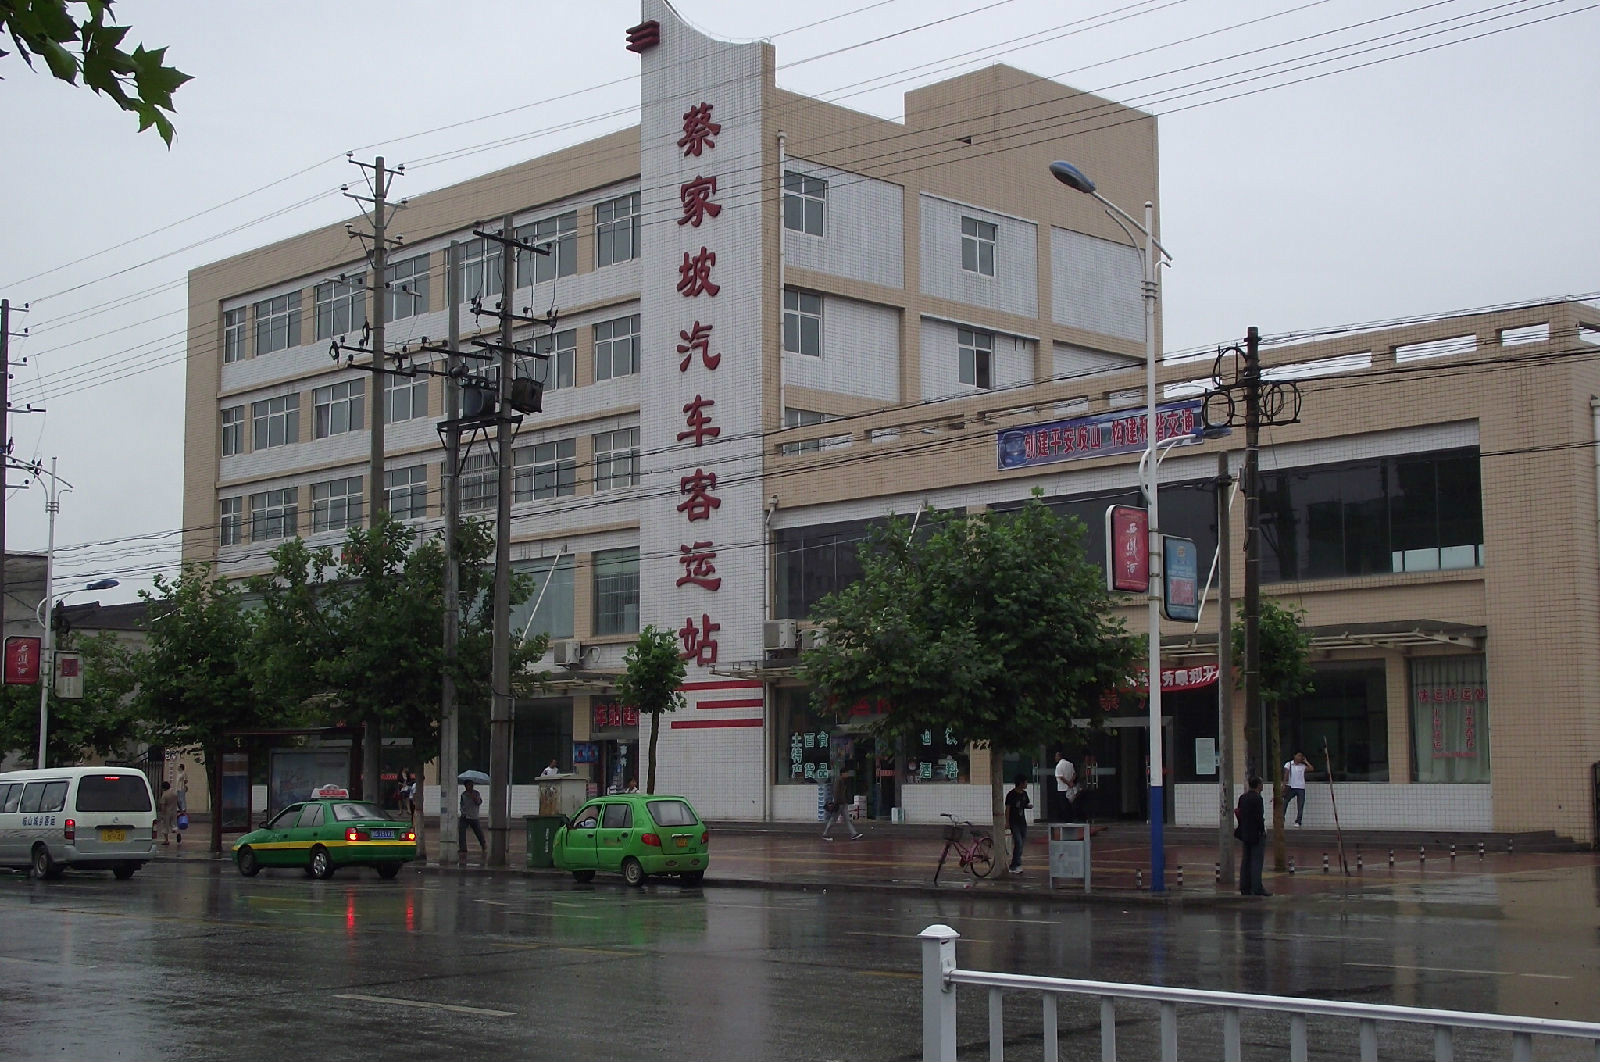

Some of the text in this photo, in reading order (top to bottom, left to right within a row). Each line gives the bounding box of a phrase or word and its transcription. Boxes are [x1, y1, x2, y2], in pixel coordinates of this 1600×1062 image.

[676, 103, 722, 667] 蔡家坡汽车客运站
[1024, 423, 1102, 458] 创建平安岐山
[791, 732, 803, 779] 土特产
[804, 732, 816, 779] 百货
[817, 731, 829, 779] 食品
